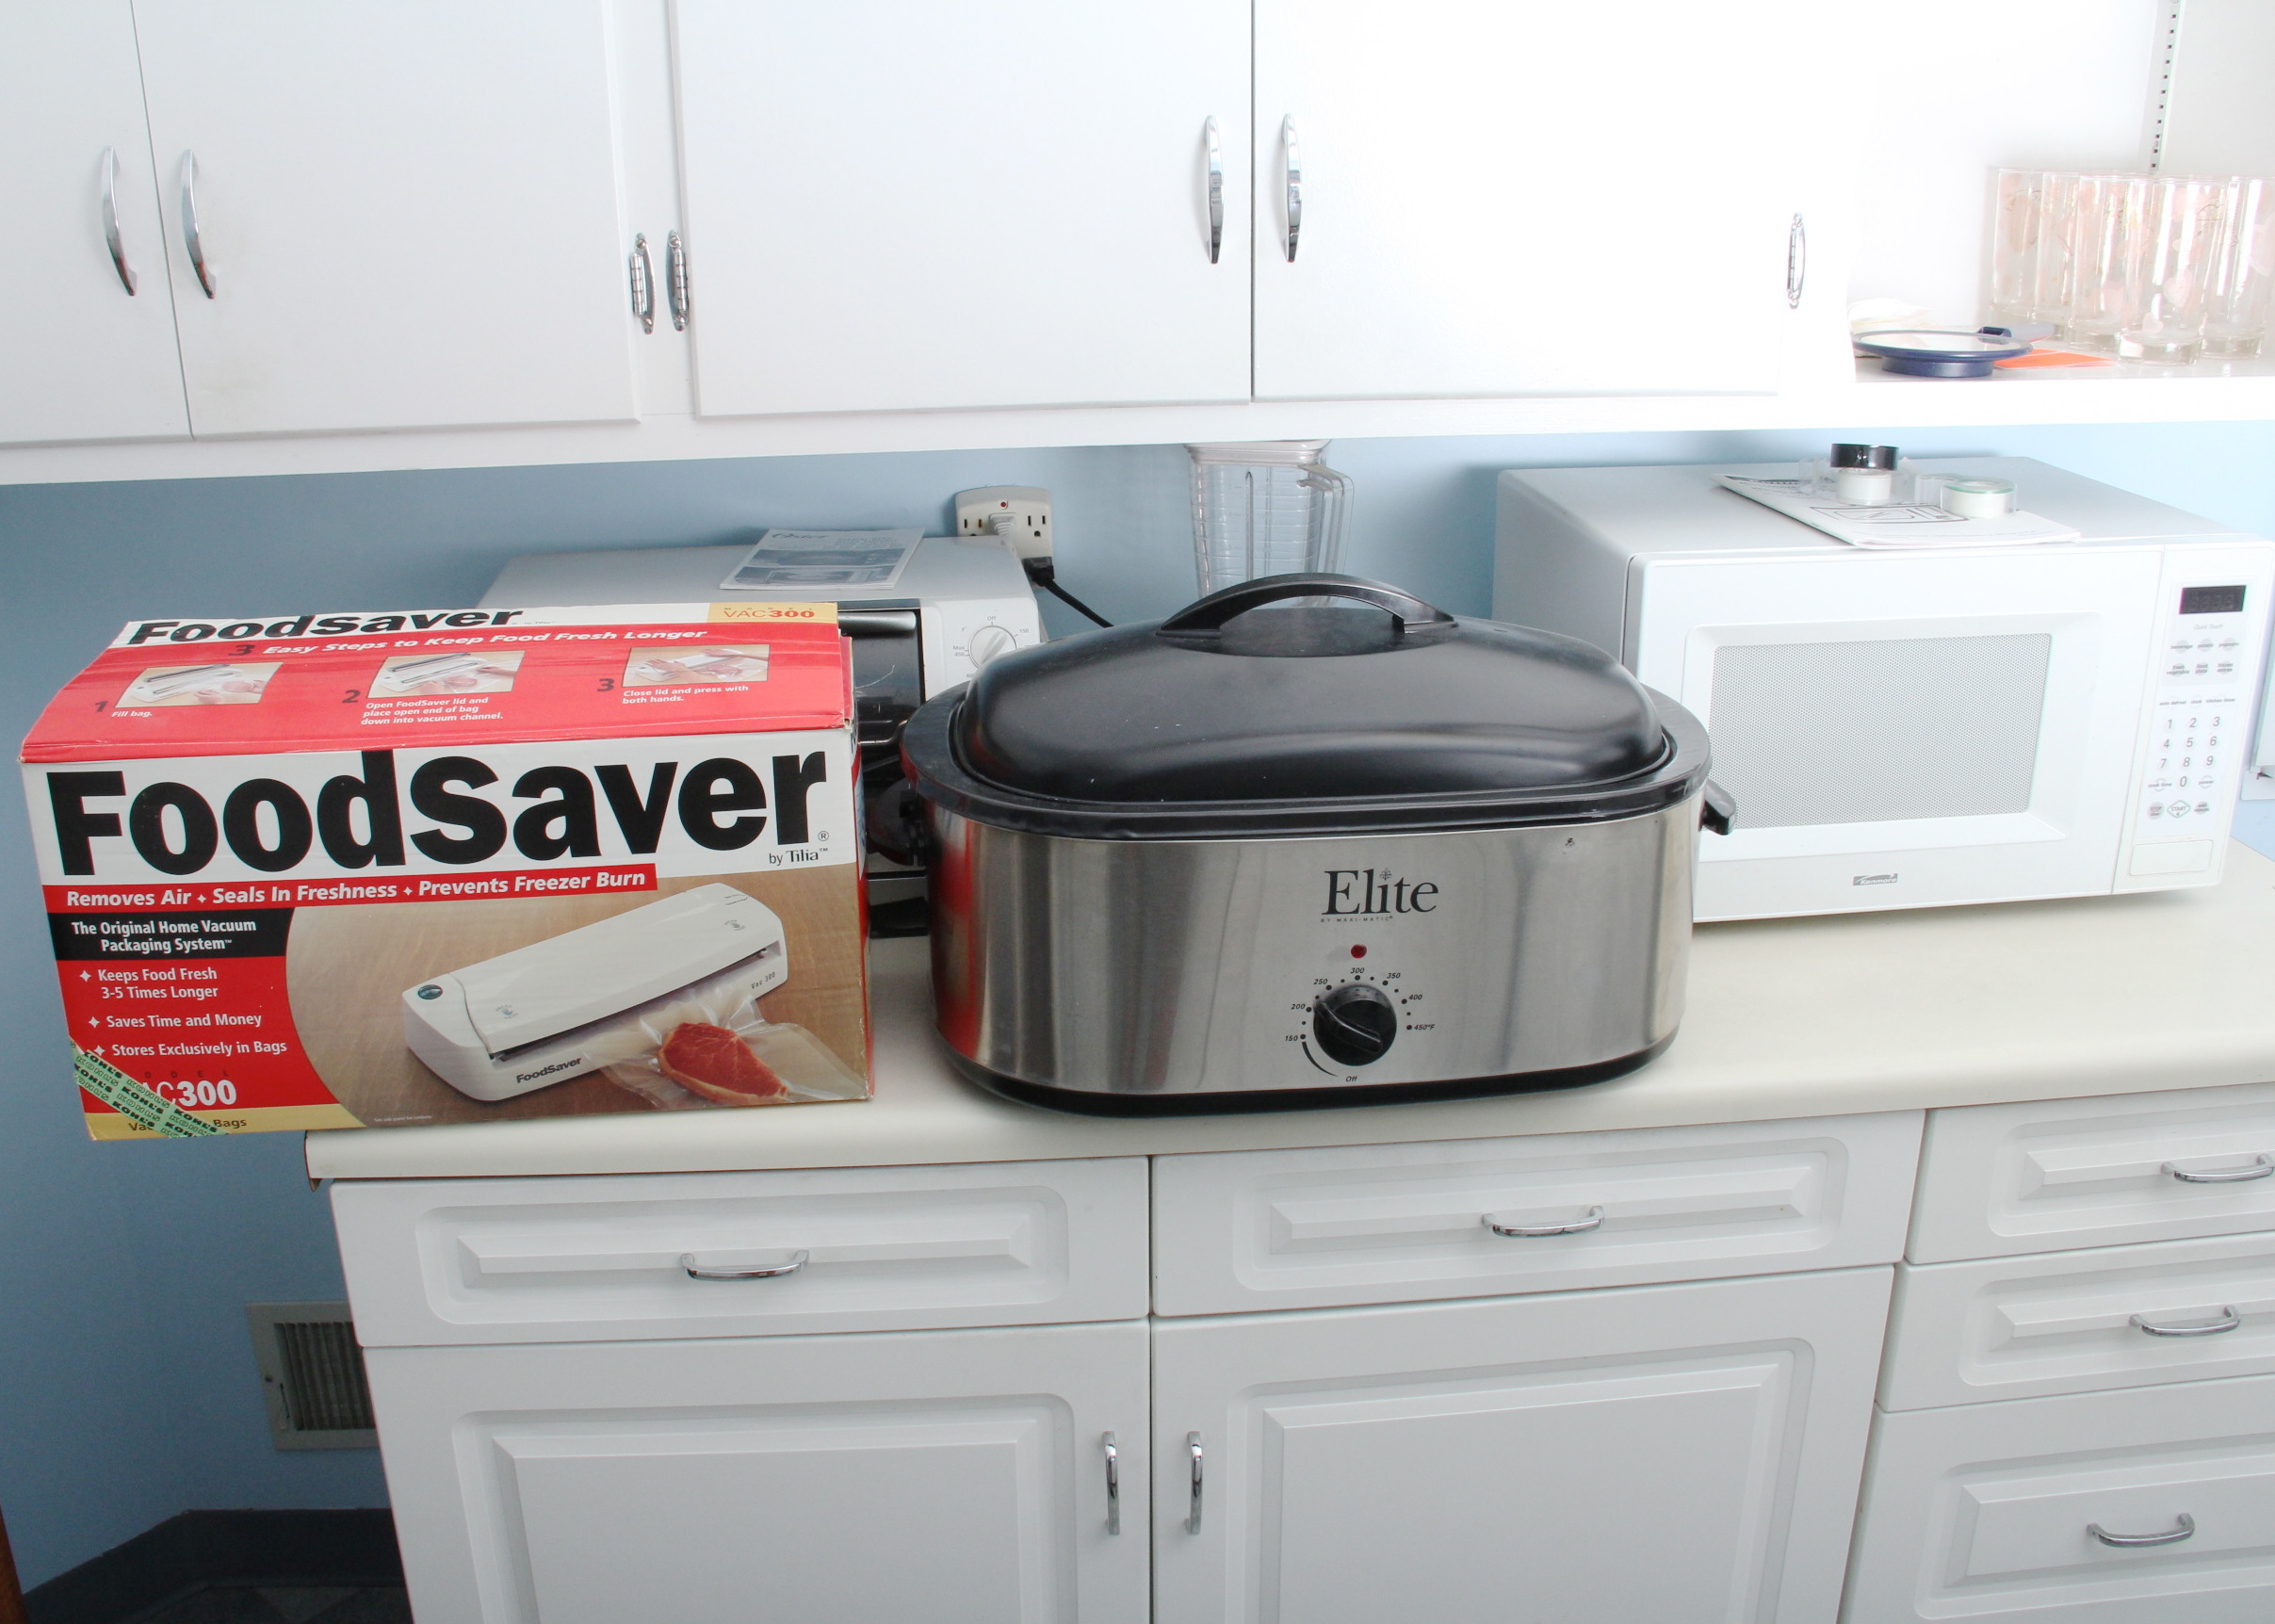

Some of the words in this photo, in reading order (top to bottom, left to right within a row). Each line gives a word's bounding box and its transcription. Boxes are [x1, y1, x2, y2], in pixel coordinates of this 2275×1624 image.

[723, 609, 815, 618] VAC300
[127, 610, 524, 645] FoodSaver
[228, 644, 255, 657] 3
[263, 645, 318, 656] Easy
[321, 641, 388, 652] Steps
[394, 640, 419, 648] to
[424, 636, 484, 646] Keep
[489, 633, 551, 642] Food
[554, 632, 618, 641] Fresh
[623, 630, 707, 641] Longer
[596, 677, 615, 692] 3
[671, 687, 691, 695] and
[693, 687, 722, 695] press
[342, 690, 361, 704] 2
[622, 696, 647, 705] both
[650, 694, 684, 703] hands.
[94, 700, 108, 713] 1
[362, 708, 391, 718] place
[394, 707, 419, 716] open
[423, 706, 442, 714] end
[445, 705, 457, 713] of
[459, 704, 479, 713] bag
[366, 702, 393, 710] Open
[396, 699, 449, 707] FoodSaver
[360, 717, 391, 725] down
[393, 715, 414, 723] into
[416, 714, 458, 723] vacuum
[460, 712, 504, 721] channel.
[2167, 719, 2173, 729] 1
[2188, 717, 2197, 728] 2
[2212, 716, 2220, 727] 3
[2163, 739, 2170, 748] 4
[2186, 737, 2194, 747] 5
[2209, 736, 2218, 746] 6
[2160, 758, 2168, 769] 7
[2183, 756, 2191, 768] 8
[2205, 755, 2214, 766] 9
[2179, 775, 2187, 788] 0
[769, 853, 784, 866] by
[1860, 877, 1897, 885] Kenmore
[67, 890, 155, 907] Removes
[160, 889, 192, 905] Air
[212, 885, 266, 904] Seals
[271, 886, 291, 901] In
[297, 883, 398, 901] Freshness
[418, 877, 509, 896] Prevents
[514, 874, 592, 892] Freezer
[596, 871, 646, 887] Burn
[1321, 868, 1439, 916] Elite
[72, 921, 97, 935] The
[100, 920, 155, 937] Original
[158, 920, 199, 934] Home
[201, 919, 257, 933] Vacuum
[100, 937, 171, 955] Packaging
[98, 968, 138, 984] Keeps
[141, 968, 176, 981] Food
[180, 966, 218, 981] Fresh
[764, 971, 776, 983] 300
[102, 986, 124, 999] 3-5
[126, 985, 168, 999] Times
[171, 985, 219, 1000] Longer
[106, 1015, 146, 1028] Saves
[147, 1014, 182, 1027] Time
[185, 1014, 211, 1027] and
[214, 1014, 262, 1028] Money
[111, 1043, 155, 1056] Stores
[157, 1042, 235, 1056] Exclusively
[236, 1041, 251, 1053] in
[253, 1041, 287, 1055] Bags
[515, 1057, 582, 1084] FoodSaver
[122, 1085, 164, 1114] KOHL'S
[112, 1100, 155, 1128] KOHL'S
[213, 1118, 247, 1129] Bags
